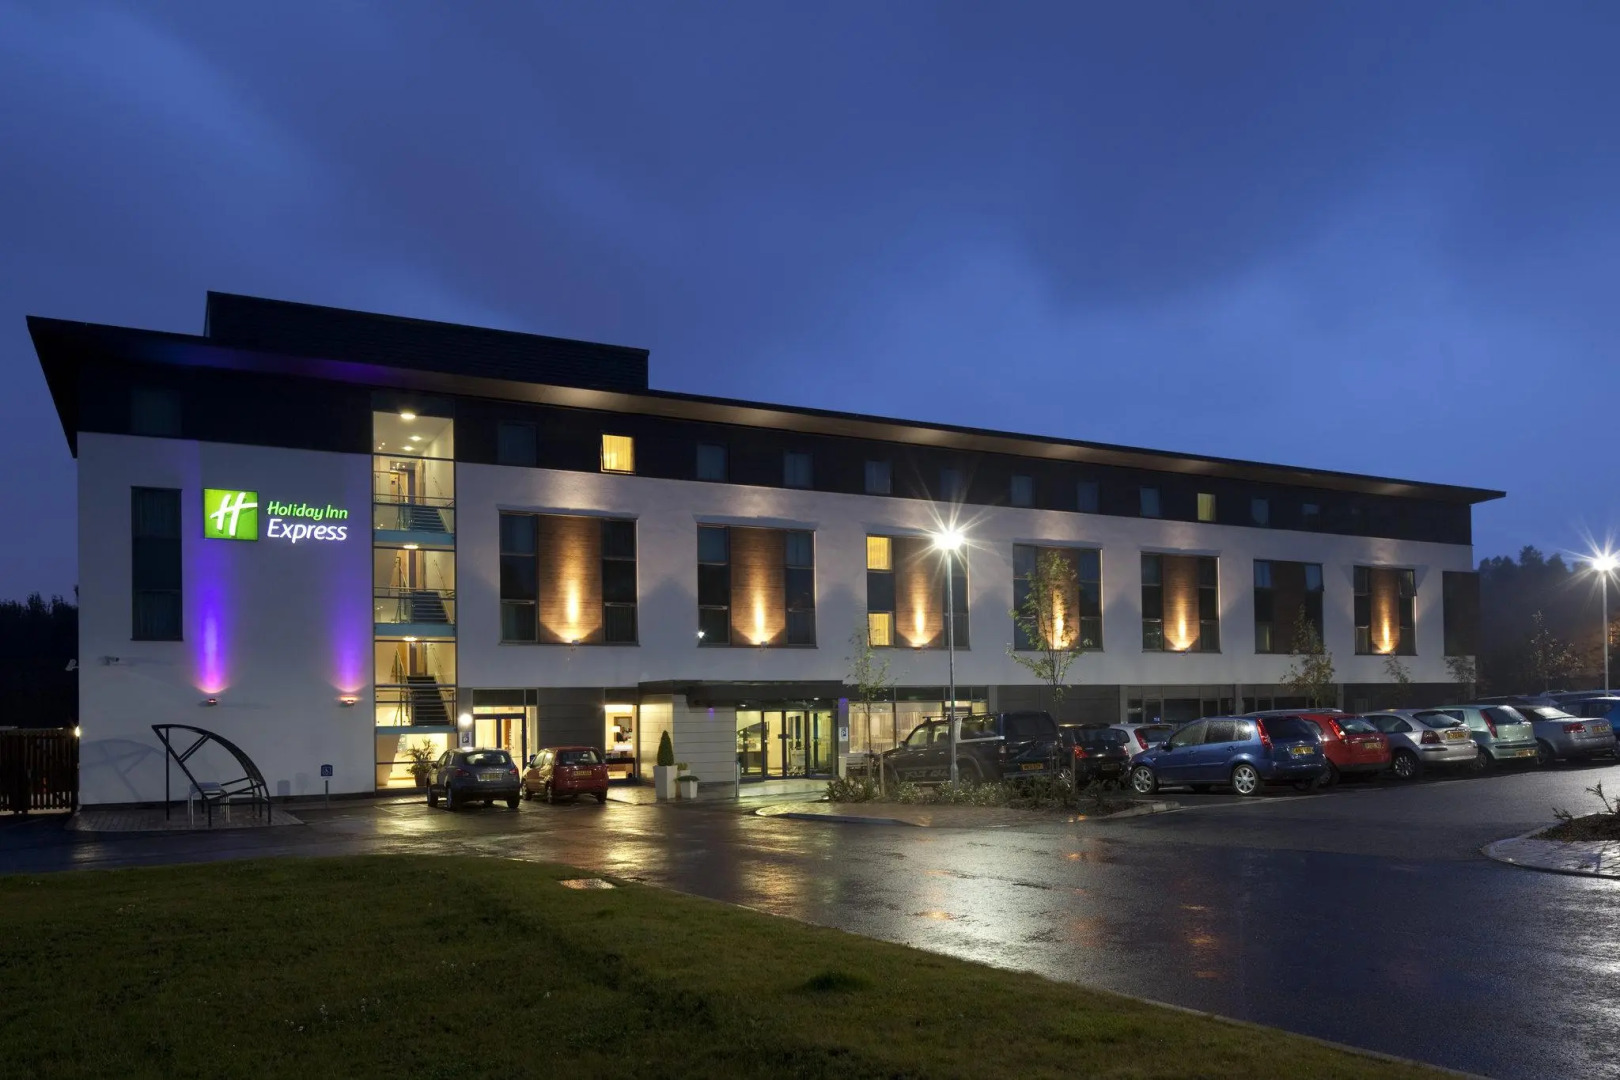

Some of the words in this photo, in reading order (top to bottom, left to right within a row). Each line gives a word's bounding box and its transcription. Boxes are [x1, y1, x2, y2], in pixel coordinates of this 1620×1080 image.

[266, 501, 323, 521] Holiday
[325, 504, 348, 519] Inn
[266, 518, 348, 544] Express
